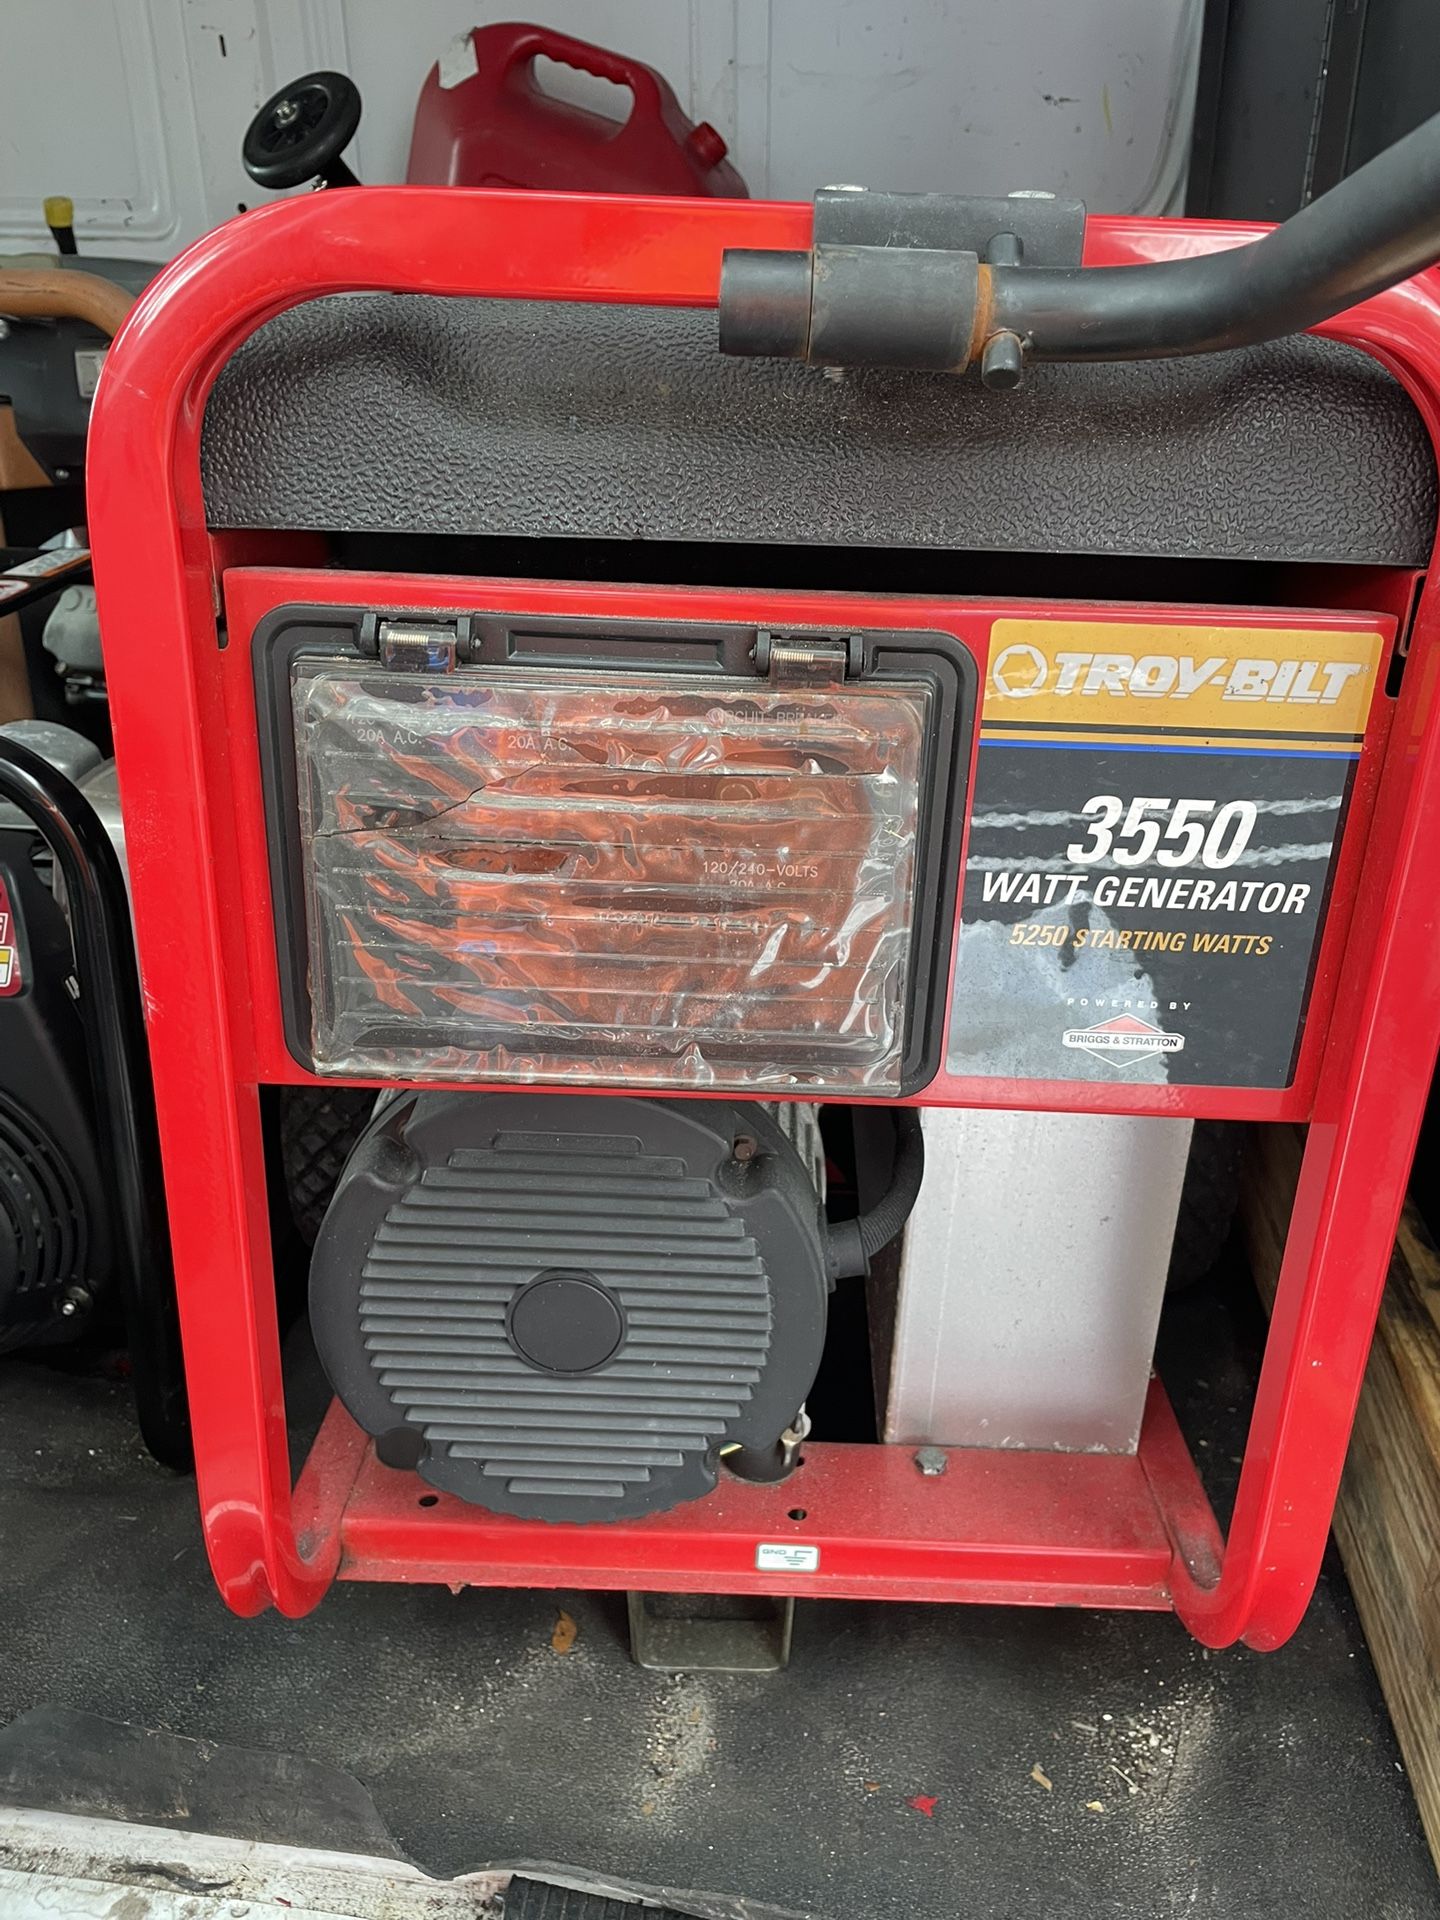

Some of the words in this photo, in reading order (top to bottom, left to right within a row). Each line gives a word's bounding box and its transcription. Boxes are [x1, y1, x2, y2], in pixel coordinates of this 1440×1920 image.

[1054, 651, 1362, 704] TROY-BILT
[357, 729, 385, 743] 20A
[508, 735, 535, 749] 20A
[1067, 795, 1257, 869] 3550
[703, 861, 818, 878] 120/240-VOLTS
[982, 872, 1089, 906] WATT
[1093, 876, 1311, 914] GENERATOR
[1009, 924, 1069, 946] 5250
[1073, 928, 1188, 951] STARTING
[1191, 932, 1273, 955] WATTS
[1067, 998, 1158, 1009] POWERED
[1169, 1002, 1191, 1010] BY
[1069, 1033, 1110, 1044] BRIGGS
[1113, 1036, 1120, 1044] &
[1122, 1037, 1178, 1047] STRATTON
